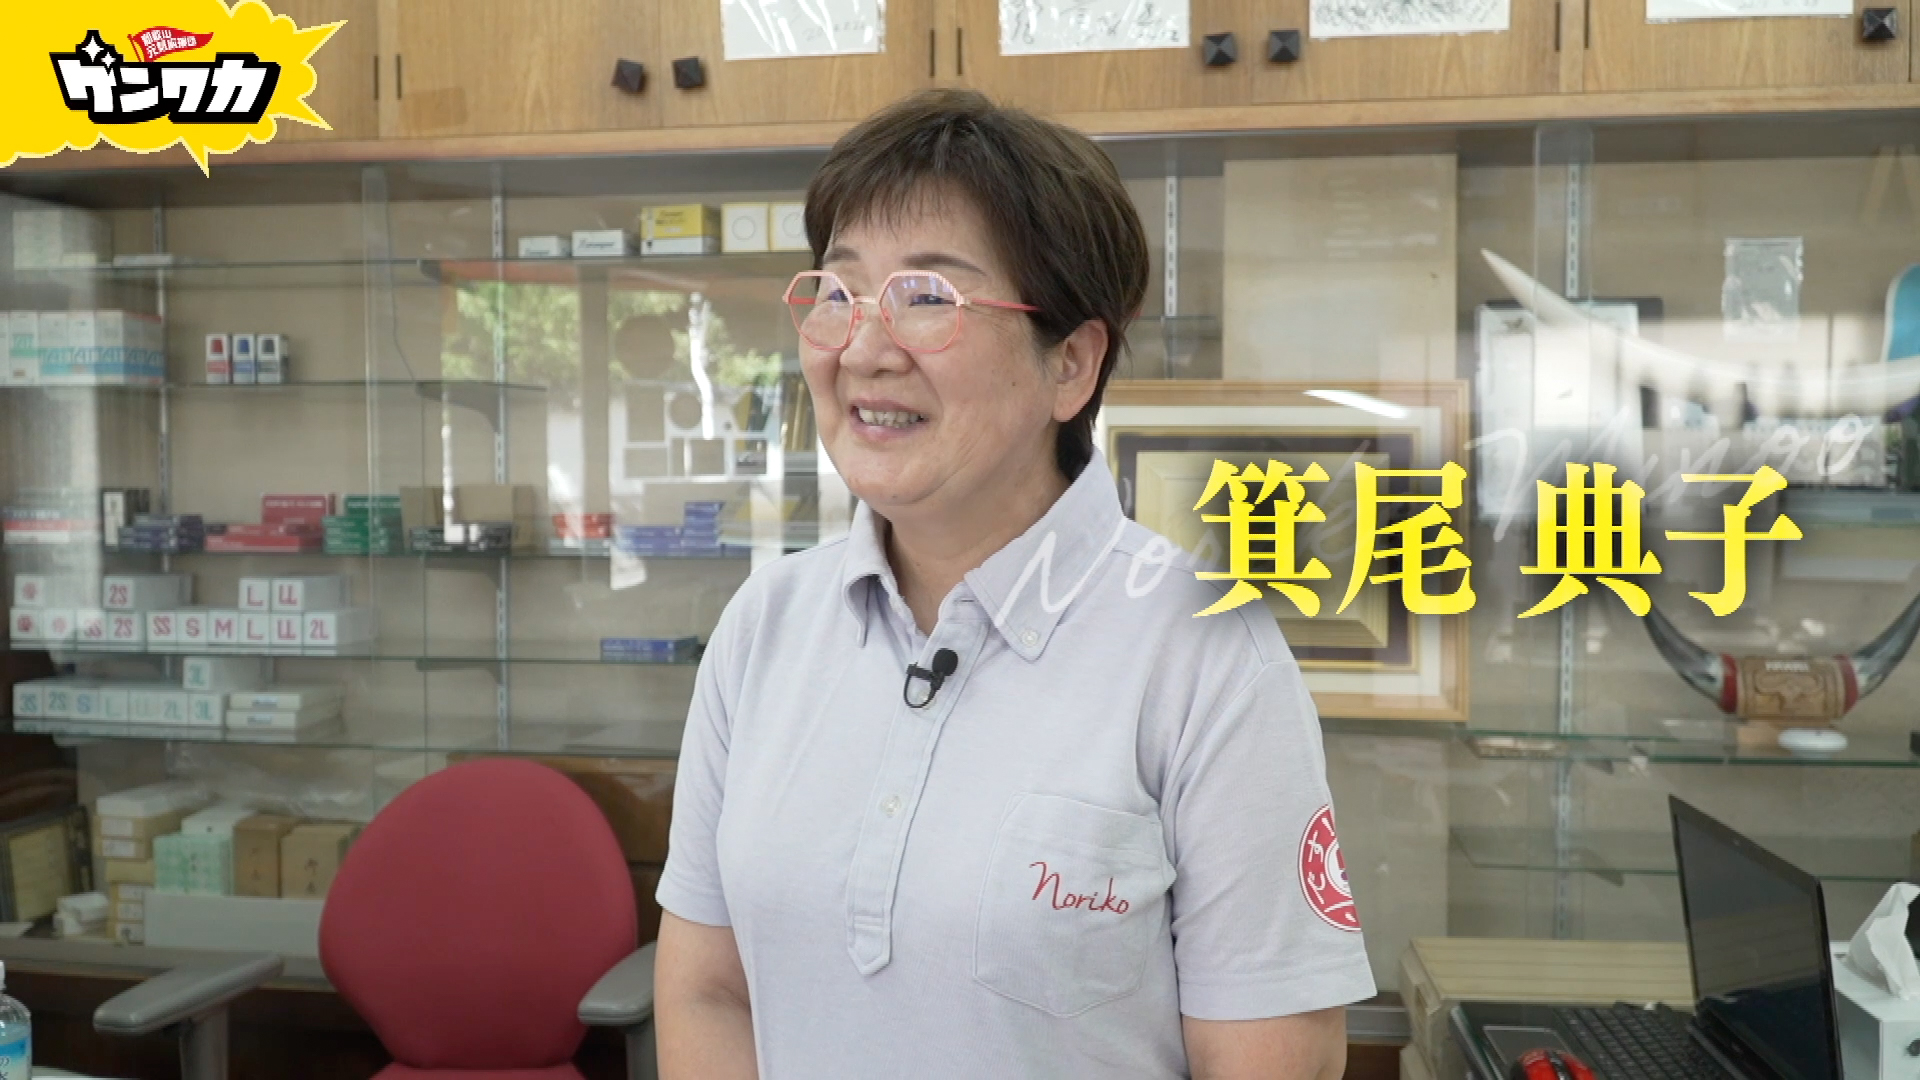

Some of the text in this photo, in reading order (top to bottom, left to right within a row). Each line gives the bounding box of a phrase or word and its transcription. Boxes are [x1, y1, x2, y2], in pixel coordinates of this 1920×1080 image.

[215, 618, 232, 639] M
[310, 618, 329, 640] 2L
[1030, 861, 1129, 914] Noriko
